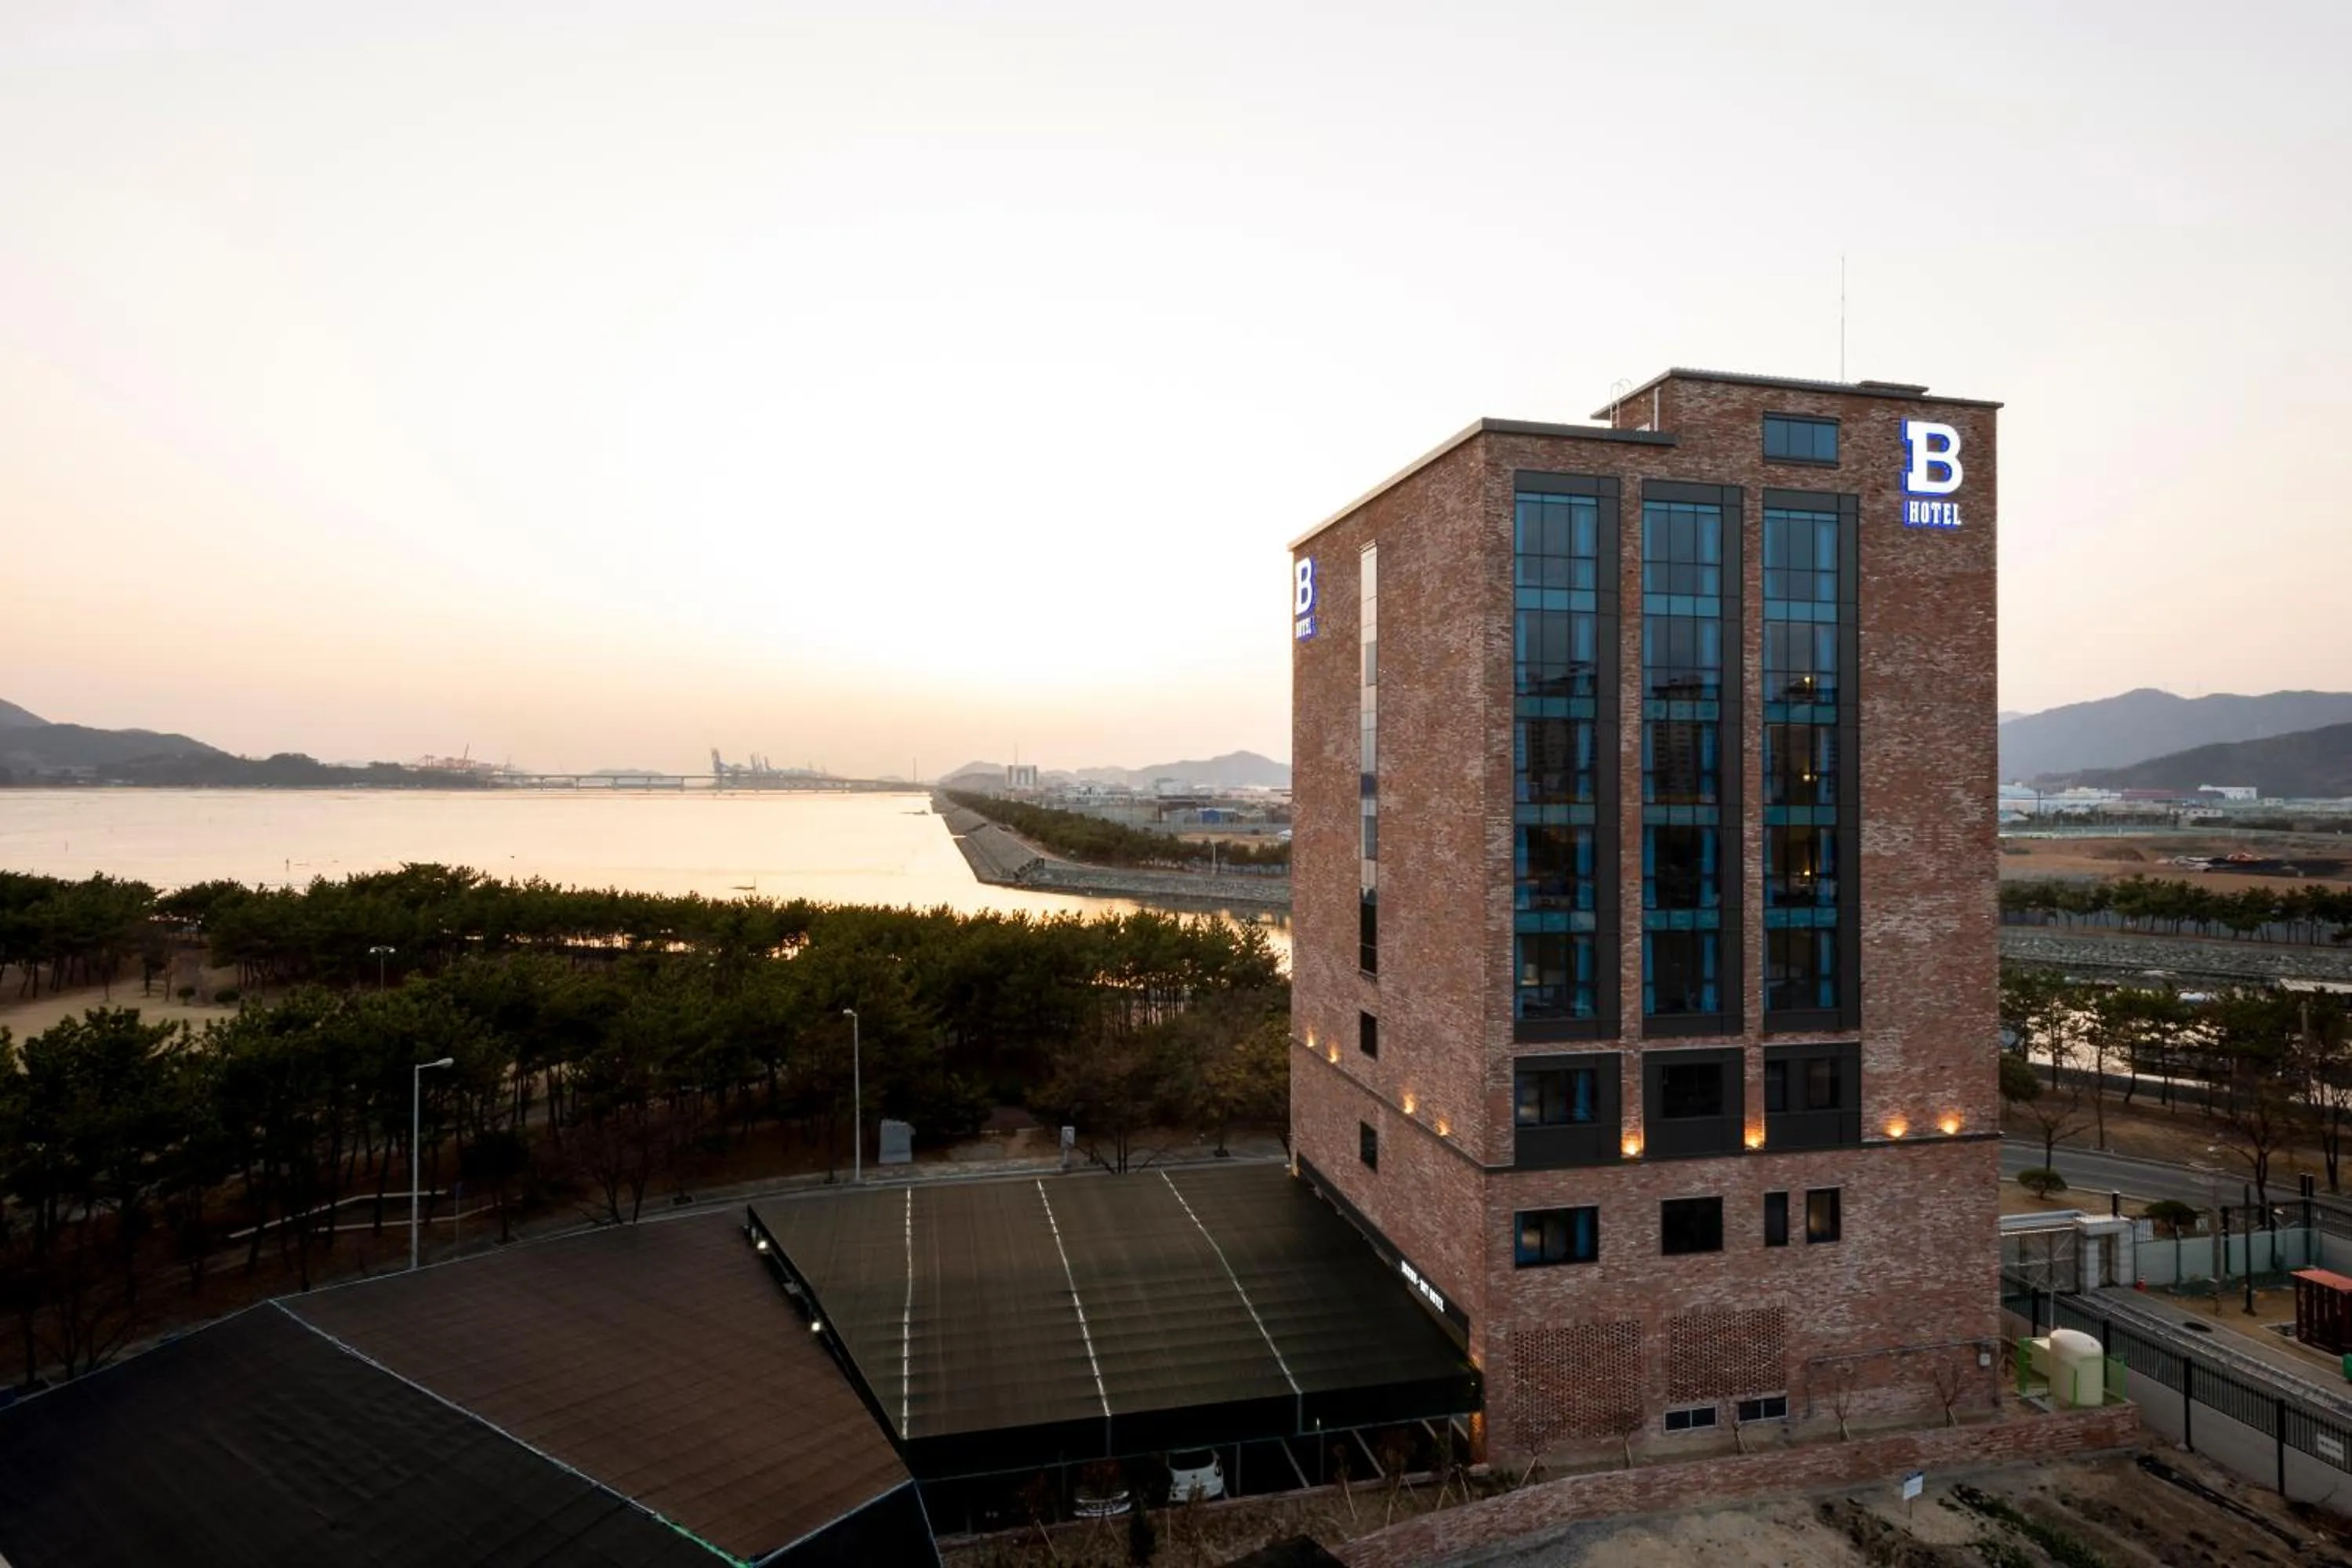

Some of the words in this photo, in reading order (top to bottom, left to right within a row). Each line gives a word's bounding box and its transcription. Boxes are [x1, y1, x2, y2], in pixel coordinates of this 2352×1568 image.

[1903, 419, 1963, 495] B
[1907, 500, 1962, 526] HOTEL
[1295, 557, 1313, 615] B
